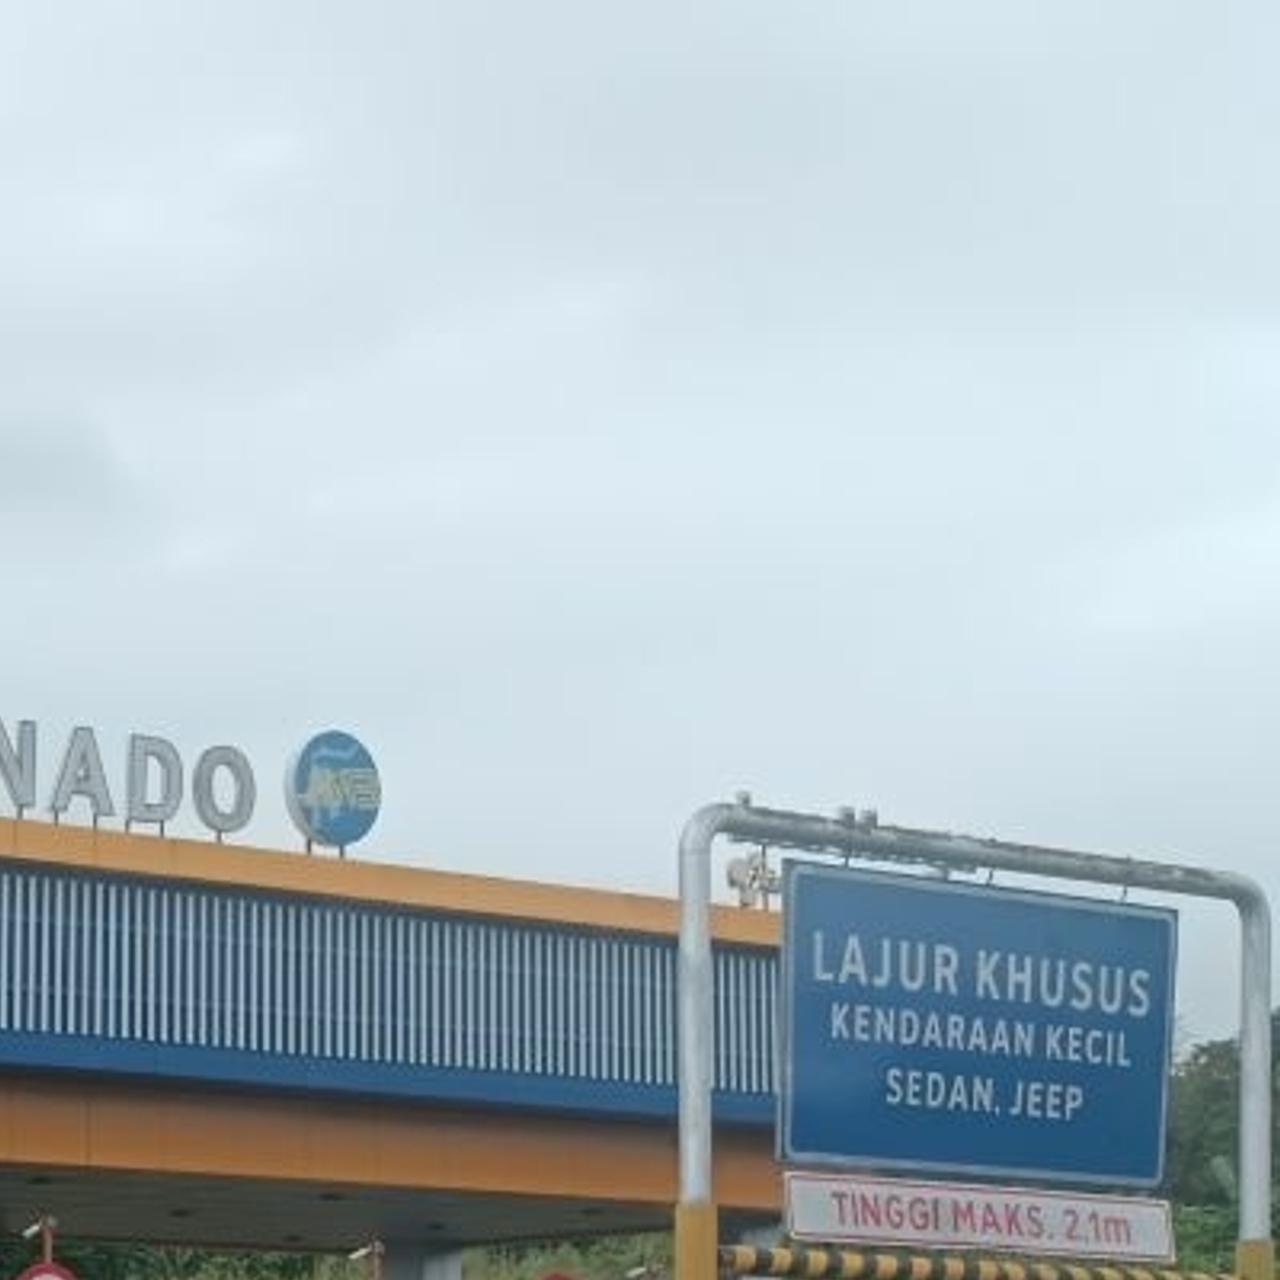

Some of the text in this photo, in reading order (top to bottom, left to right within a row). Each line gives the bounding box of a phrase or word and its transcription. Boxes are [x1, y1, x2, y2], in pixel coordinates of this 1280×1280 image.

[813, 930, 1152, 1017] LAJUR KHUSUS
[831, 1003, 1132, 1067] KENDARAAN KECIL
[1010, 1081, 1085, 1120] JEEP
[831, 1191, 939, 1231] TINGGI
